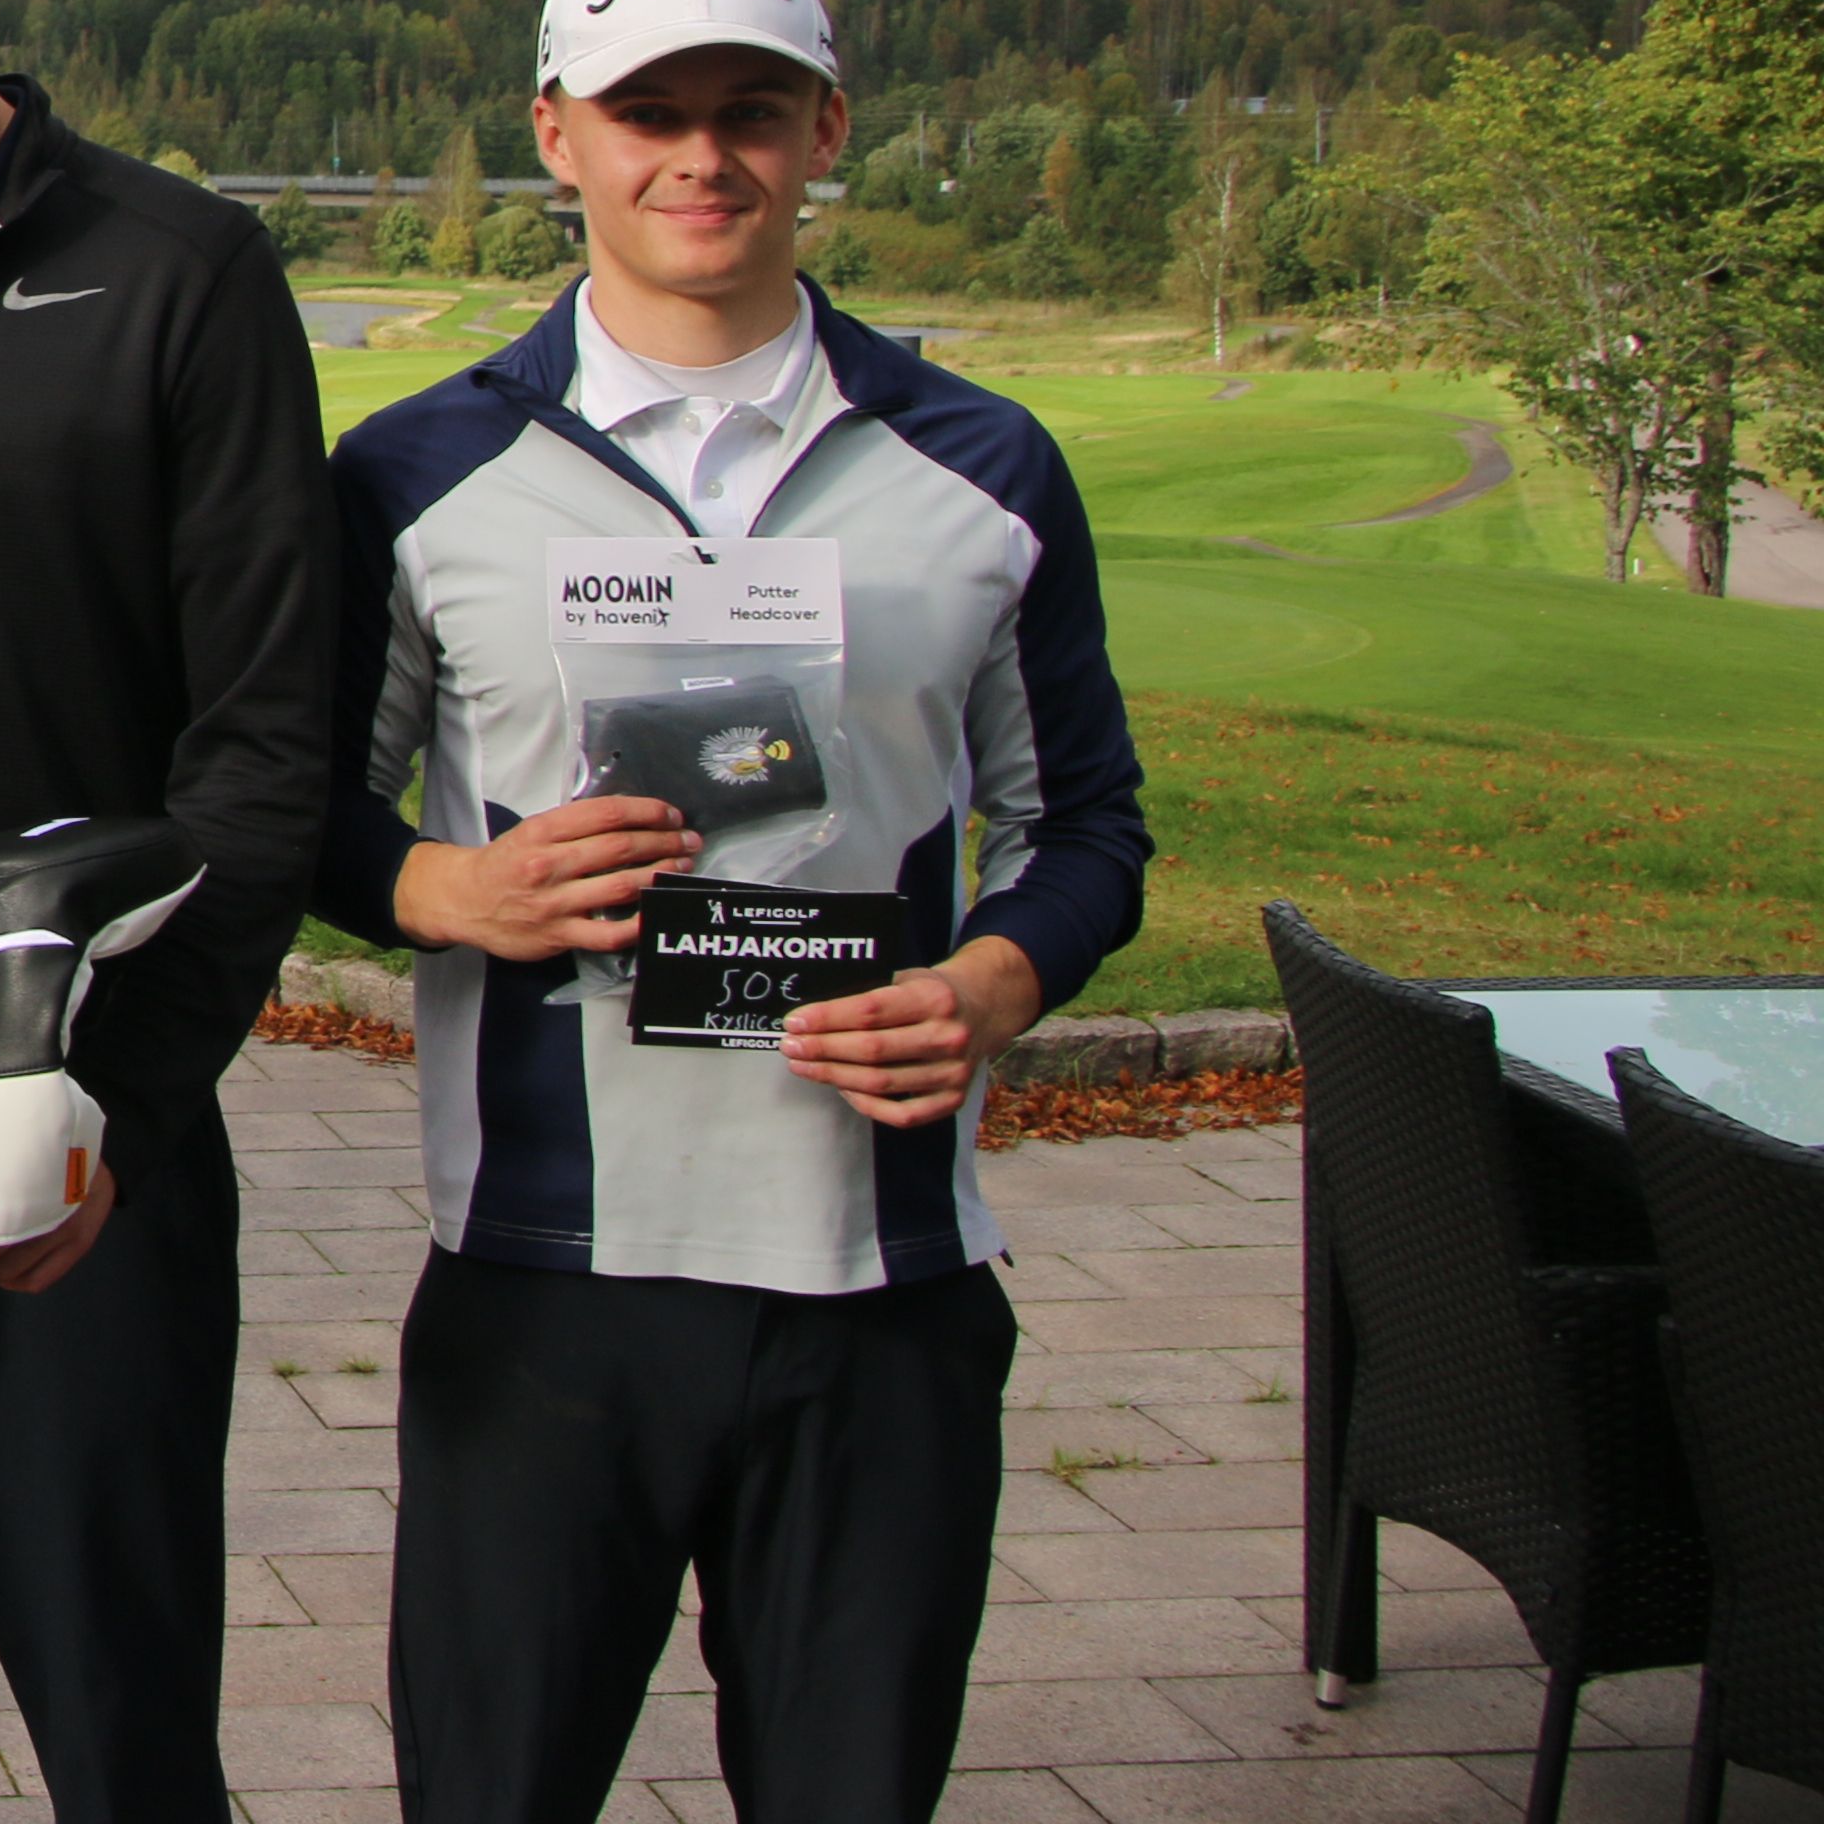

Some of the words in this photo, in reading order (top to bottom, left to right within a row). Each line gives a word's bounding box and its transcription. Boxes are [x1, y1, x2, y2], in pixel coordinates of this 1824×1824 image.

[562, 574, 673, 604] MOOMIN
[747, 585, 800, 600] Putter
[565, 609, 587, 626] by
[729, 606, 820, 622] Headcover
[732, 906, 820, 919] LEFIGOLF
[656, 932, 875, 960] LAHJAKORTTI
